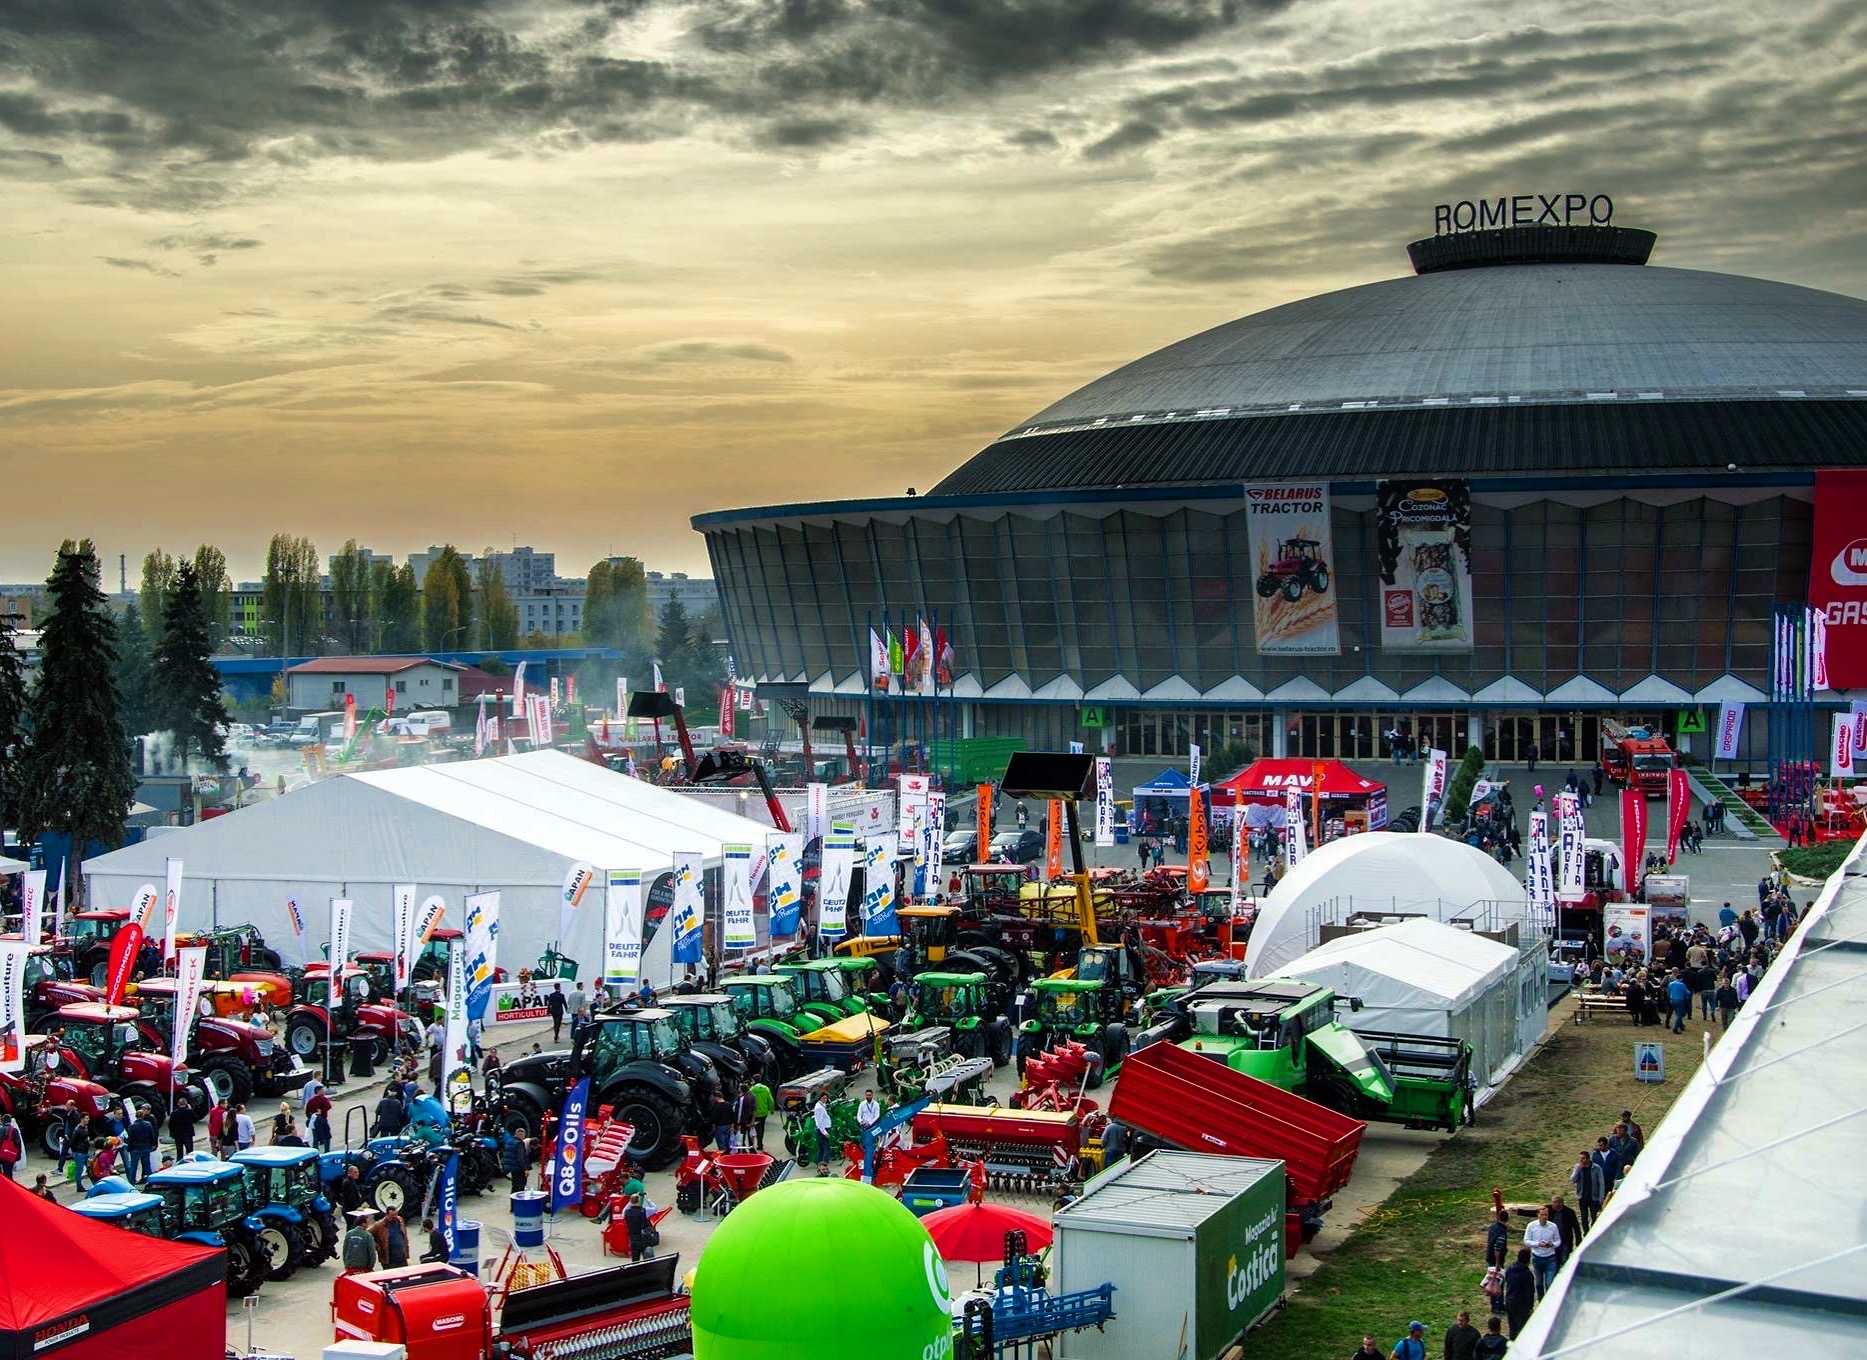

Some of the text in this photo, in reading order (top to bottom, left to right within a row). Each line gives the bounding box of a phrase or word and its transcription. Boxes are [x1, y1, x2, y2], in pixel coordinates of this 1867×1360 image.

[1435, 194, 1613, 234] ROMEXPO
[1251, 502, 1323, 514] TRACTOR
[1264, 488, 1323, 500] BELARUS
[1085, 708, 1099, 723] A
[1682, 711, 1701, 728] A
[1855, 712, 1865, 746] MASCHIO
[1723, 710, 1737, 752] GASPARDO
[1838, 724, 1847, 762] MASCHIO
[1262, 774, 1313, 787] MAV
[1193, 799, 1207, 856] Kubota
[1287, 826, 1297, 866] AGR
[570, 869, 586, 896] APAN
[136, 893, 150, 921] APAN
[420, 904, 438, 932] APAN
[725, 909, 751, 917] DEUTZ
[608, 942, 641, 950] DEUTZ
[611, 950, 638, 958] FAHR
[109, 942, 132, 1005] McCORMICK
[451, 966, 463, 1021] Magazia
[558, 1101, 582, 1197] Q8 Oils
[1245, 1212, 1271, 1245] Magazia
[1227, 1230, 1279, 1311] Costică
[34, 1312, 90, 1343] HONDA
[59, 1327, 80, 1339] PRODUCTS
[436, 1314, 465, 1327] MASCHIO
